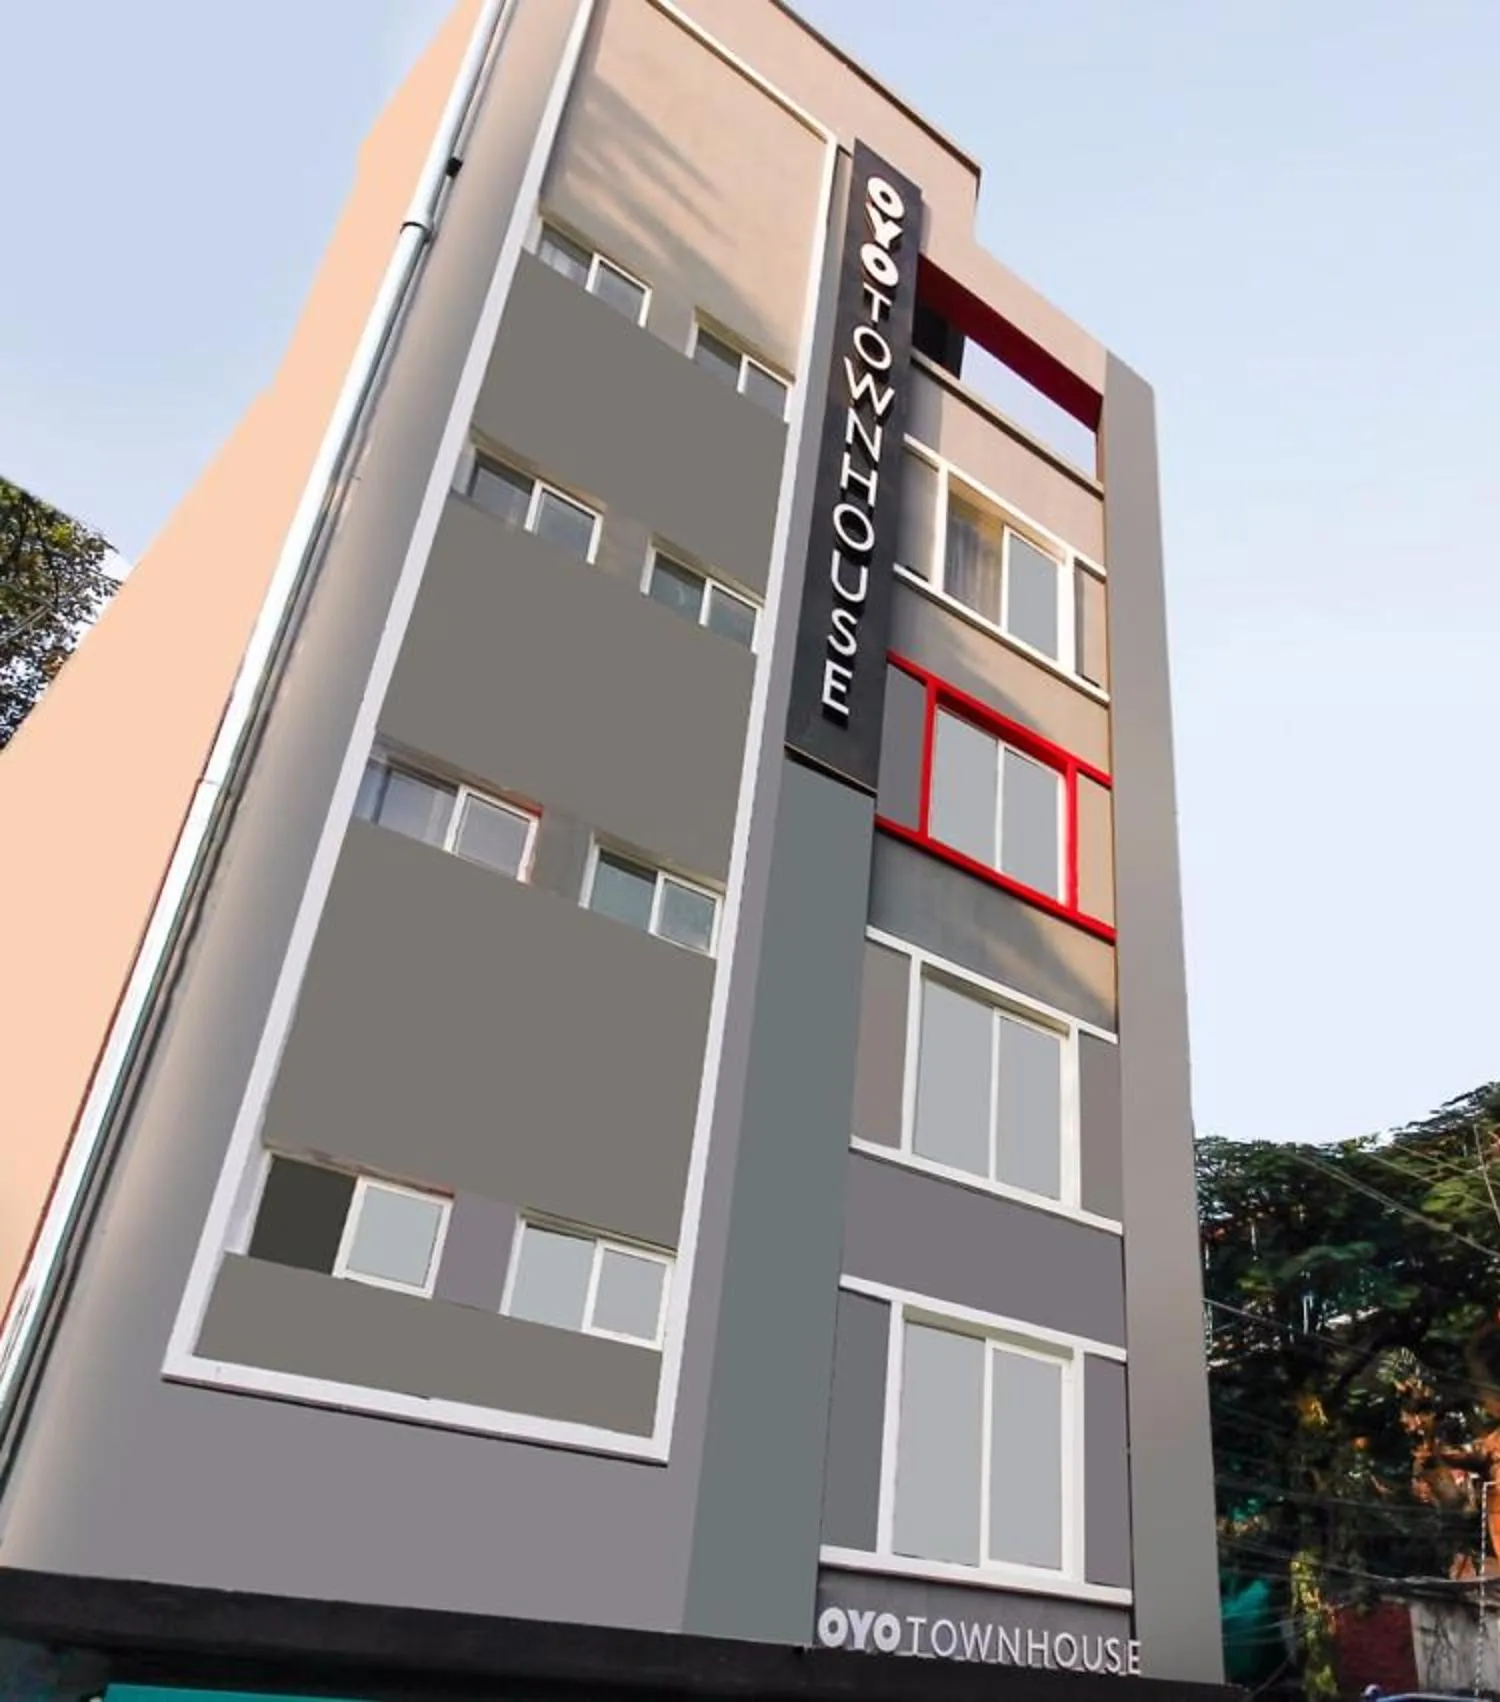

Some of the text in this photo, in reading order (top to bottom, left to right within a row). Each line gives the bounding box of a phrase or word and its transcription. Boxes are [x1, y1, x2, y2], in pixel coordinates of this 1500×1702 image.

[821, 177, 905, 716] OYO TOWNHOUSE
[818, 1607, 1142, 1675] OYO TOWNHOUSE
